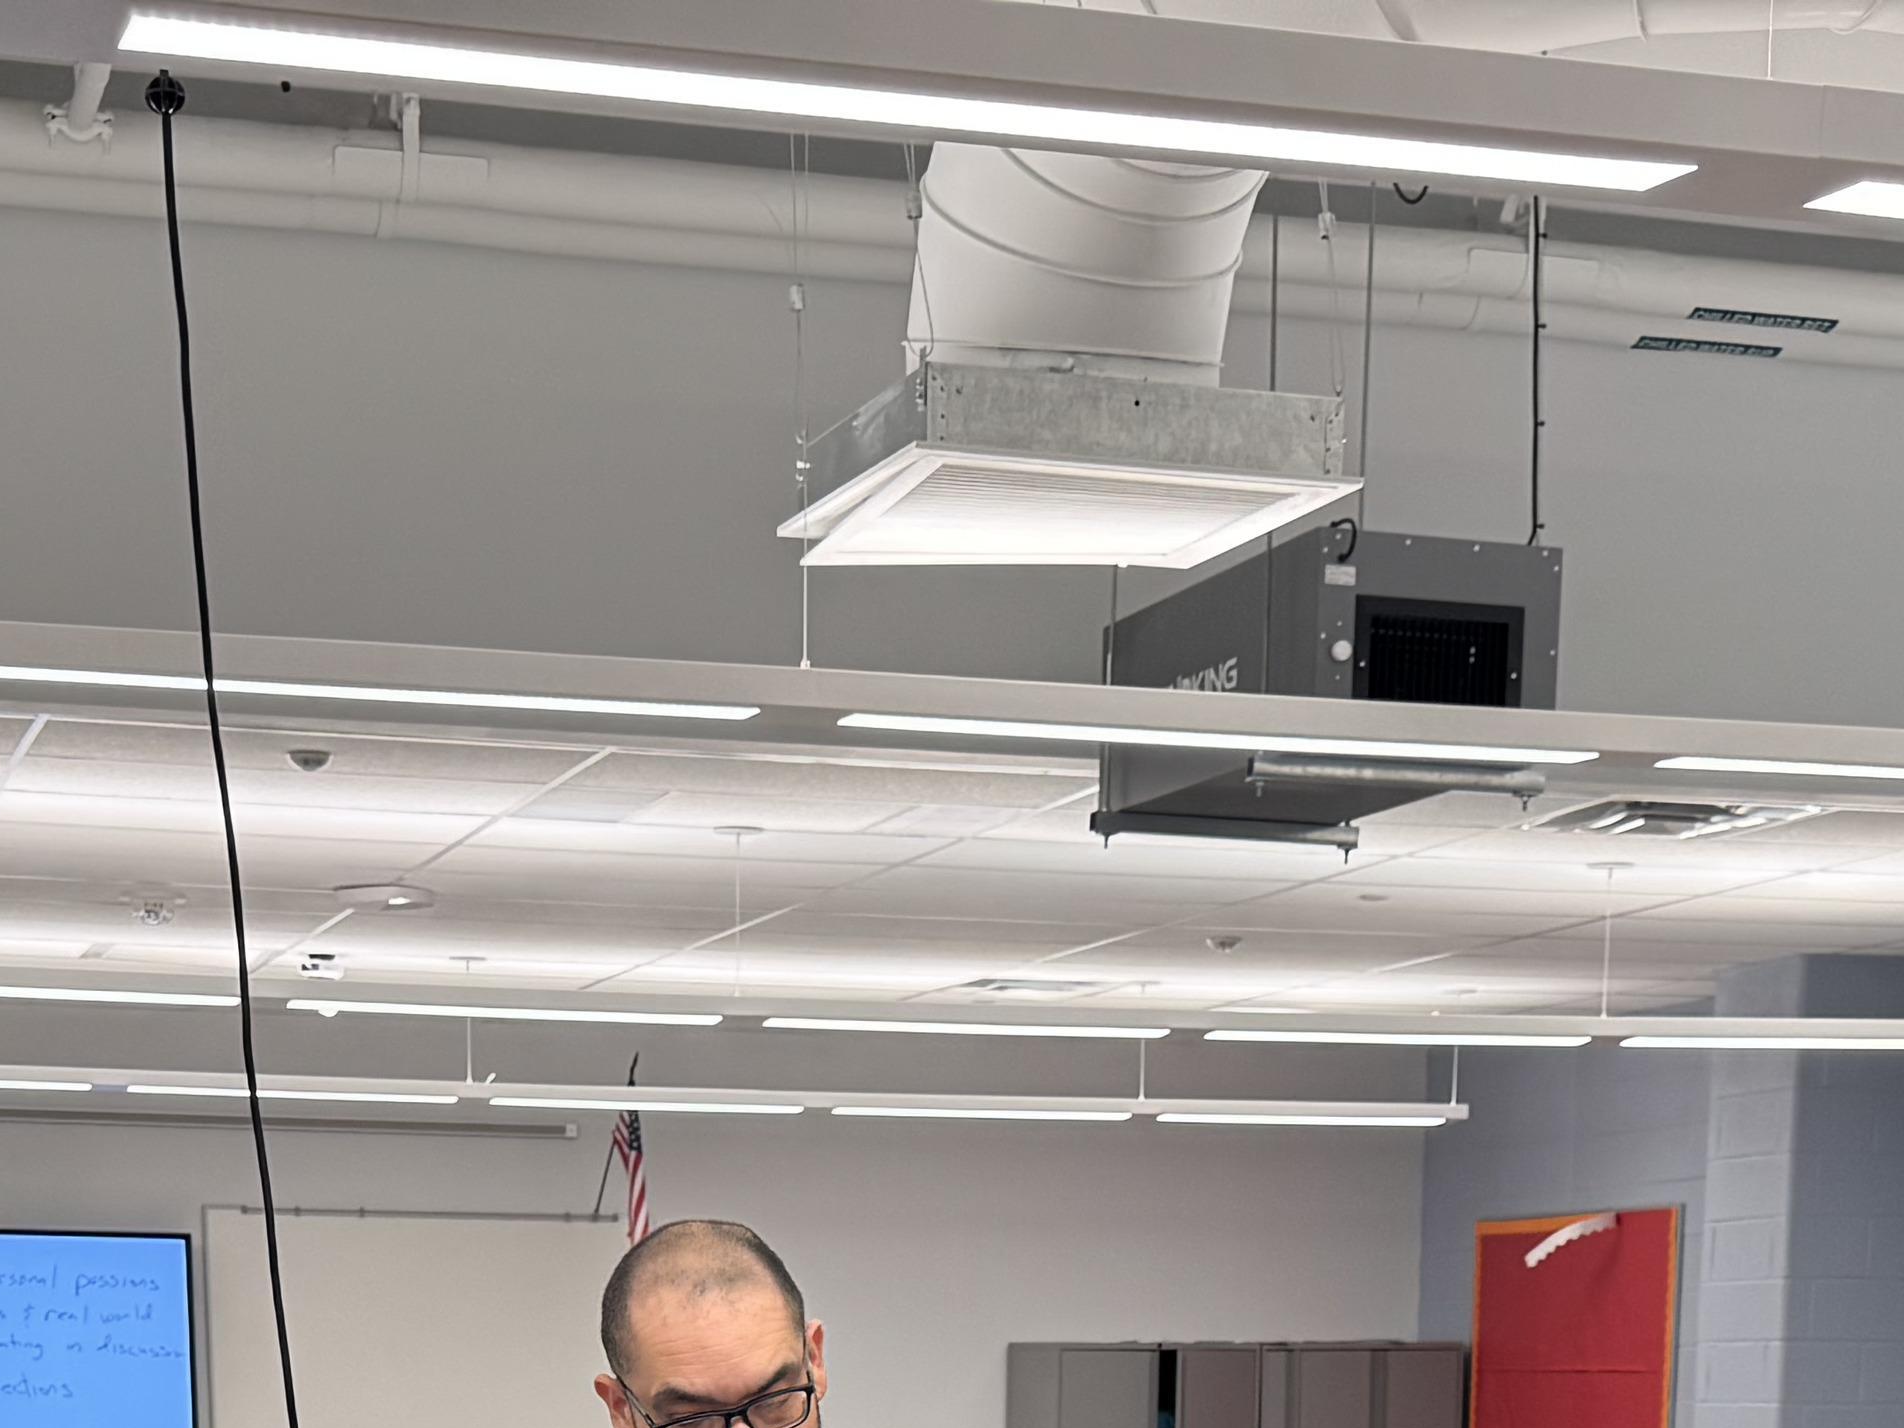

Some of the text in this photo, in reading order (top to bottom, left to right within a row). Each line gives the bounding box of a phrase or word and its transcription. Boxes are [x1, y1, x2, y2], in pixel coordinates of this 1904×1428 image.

[75, 1273, 160, 1297] passions
[44, 1304, 88, 1325] real
[99, 1303, 153, 1324] world
